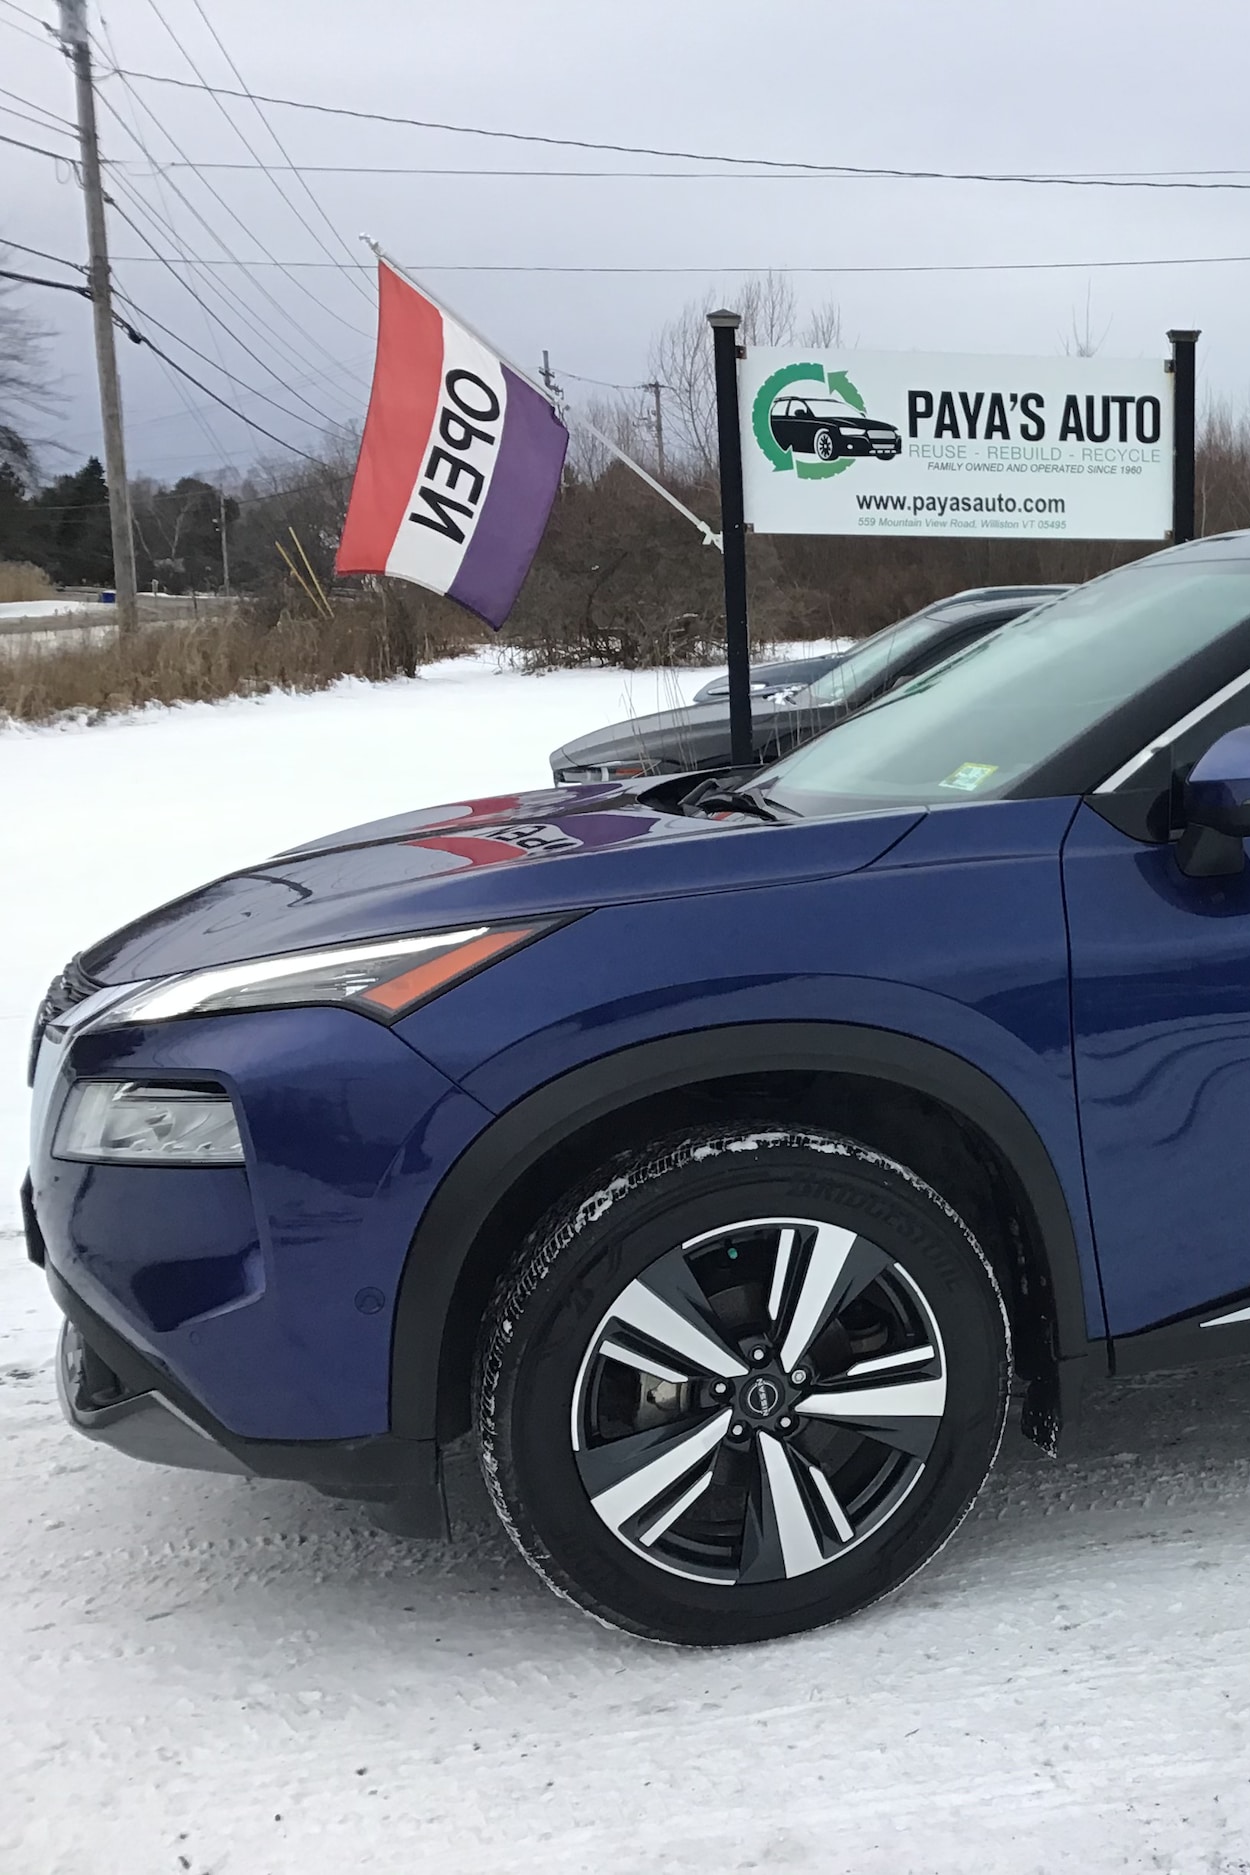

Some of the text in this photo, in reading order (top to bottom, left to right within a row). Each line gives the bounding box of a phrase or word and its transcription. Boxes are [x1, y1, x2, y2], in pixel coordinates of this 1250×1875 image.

[907, 390, 1162, 444] PAYA'S AUTO
[908, 444, 968, 459] REUSE
[987, 446, 1062, 461] REBUILD
[1081, 447, 1161, 463] RECYCLE
[928, 462, 1142, 475] FAMILY OWNED AND OPERATED SINCE 1960
[855, 493, 1066, 516] www.payasauto.com
[857, 517, 876, 527] 559
[878, 517, 922, 528] Mountain
[925, 518, 948, 528] View
[980, 519, 1019, 529] Williston
[1021, 520, 1036, 529] VT
[1037, 520, 1067, 530] 05495
[755, 1378, 770, 1417] NISSAN
